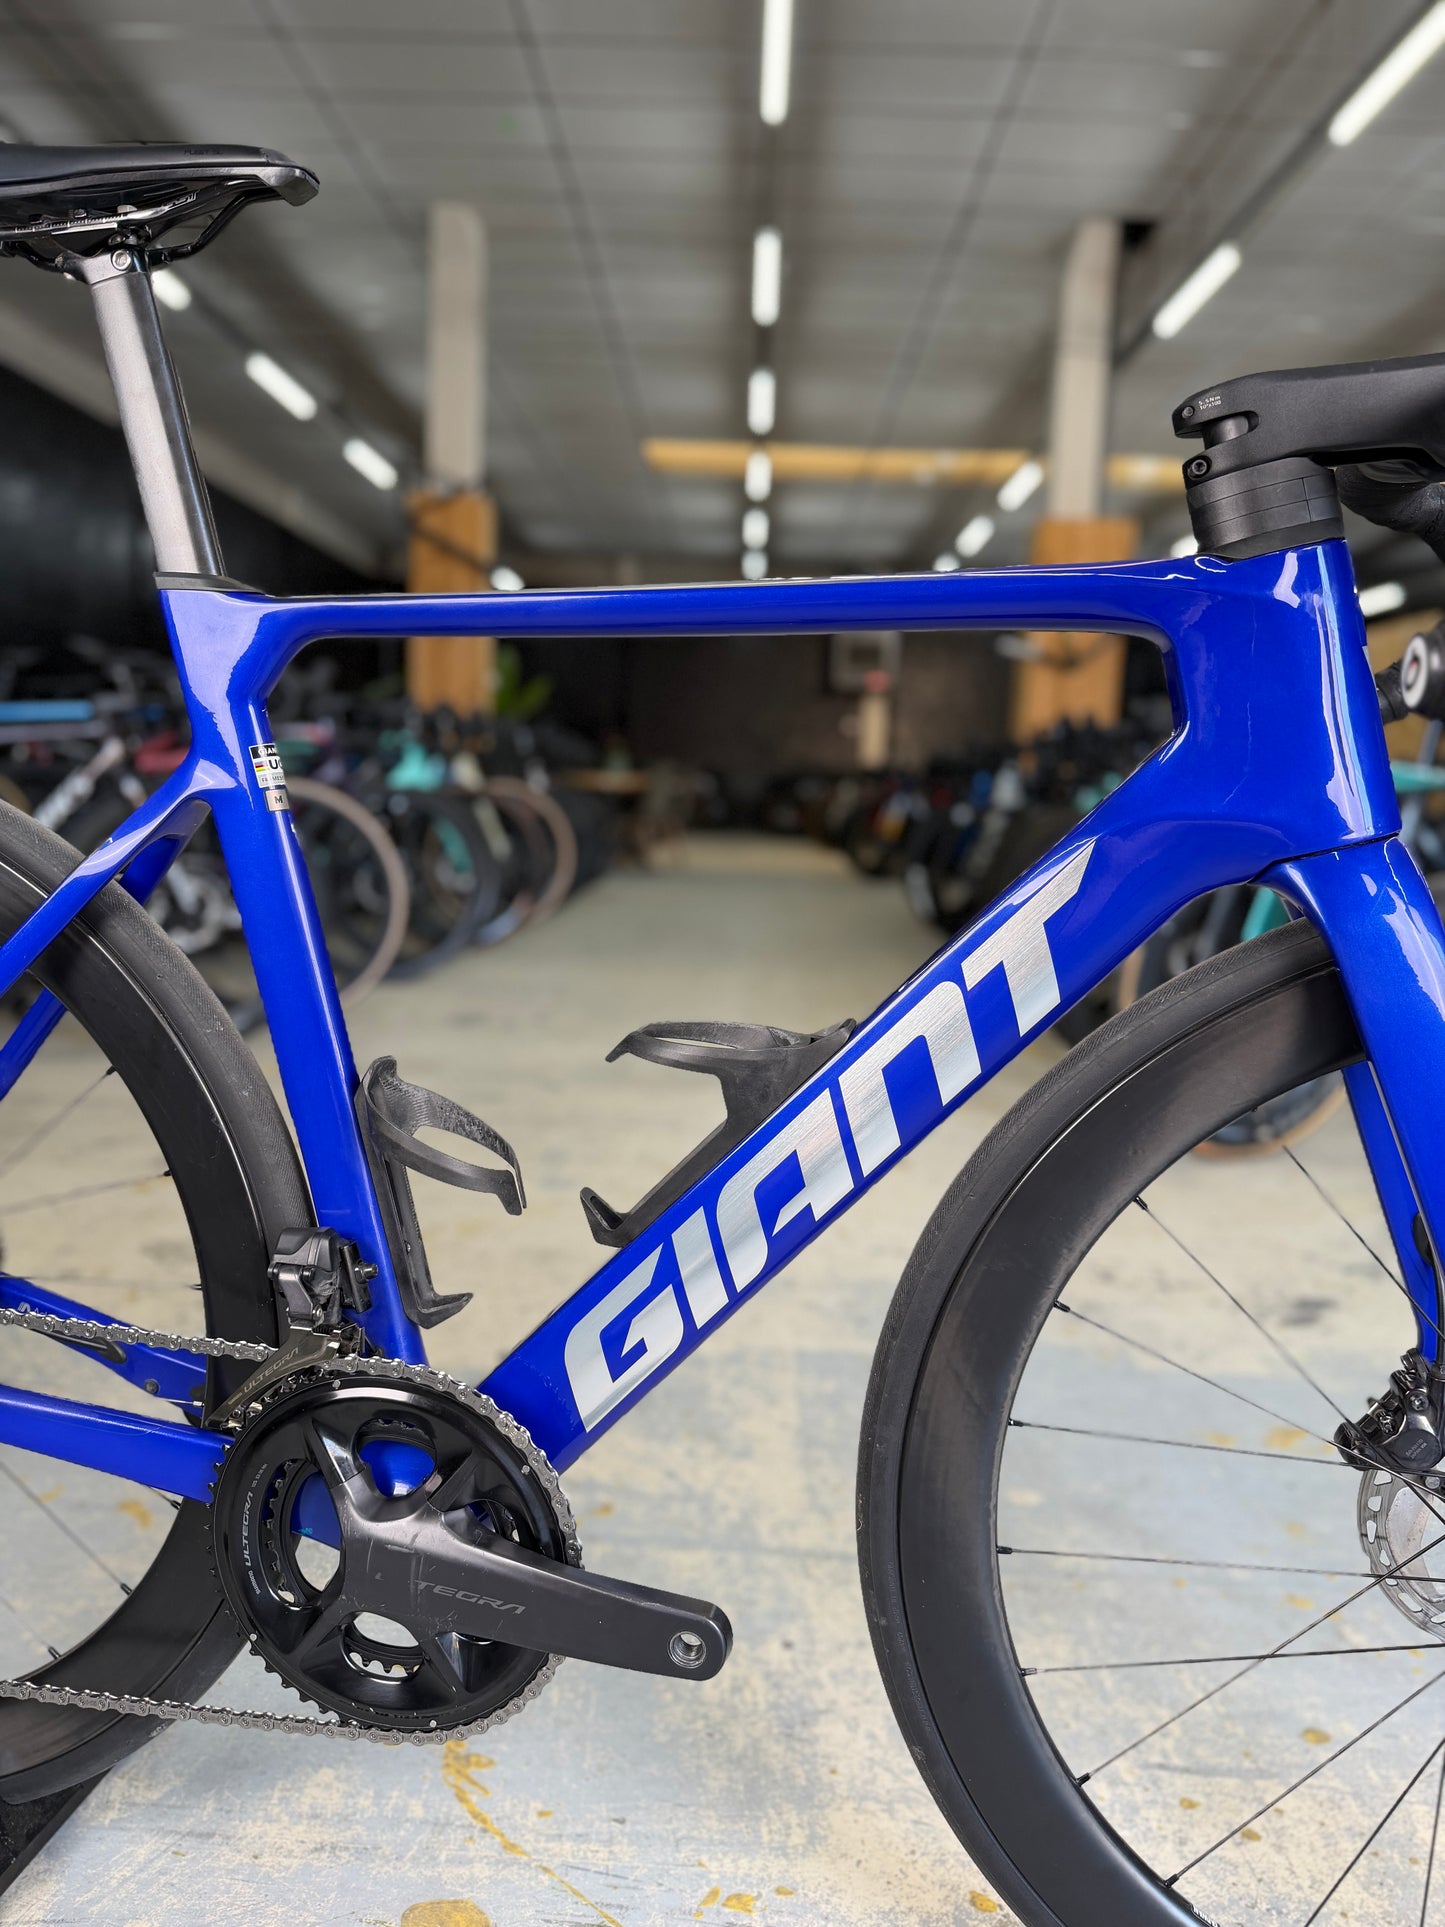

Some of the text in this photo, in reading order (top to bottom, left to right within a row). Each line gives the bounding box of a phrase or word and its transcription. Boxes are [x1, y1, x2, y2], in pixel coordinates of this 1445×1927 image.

[275, 796, 284, 804] M
[564, 839, 1096, 1433] GIANT
[244, 1347, 299, 1393] ULTEGRA
[242, 1491, 253, 1567] ULTEGRA
[374, 1572, 526, 1615] TEGRA
